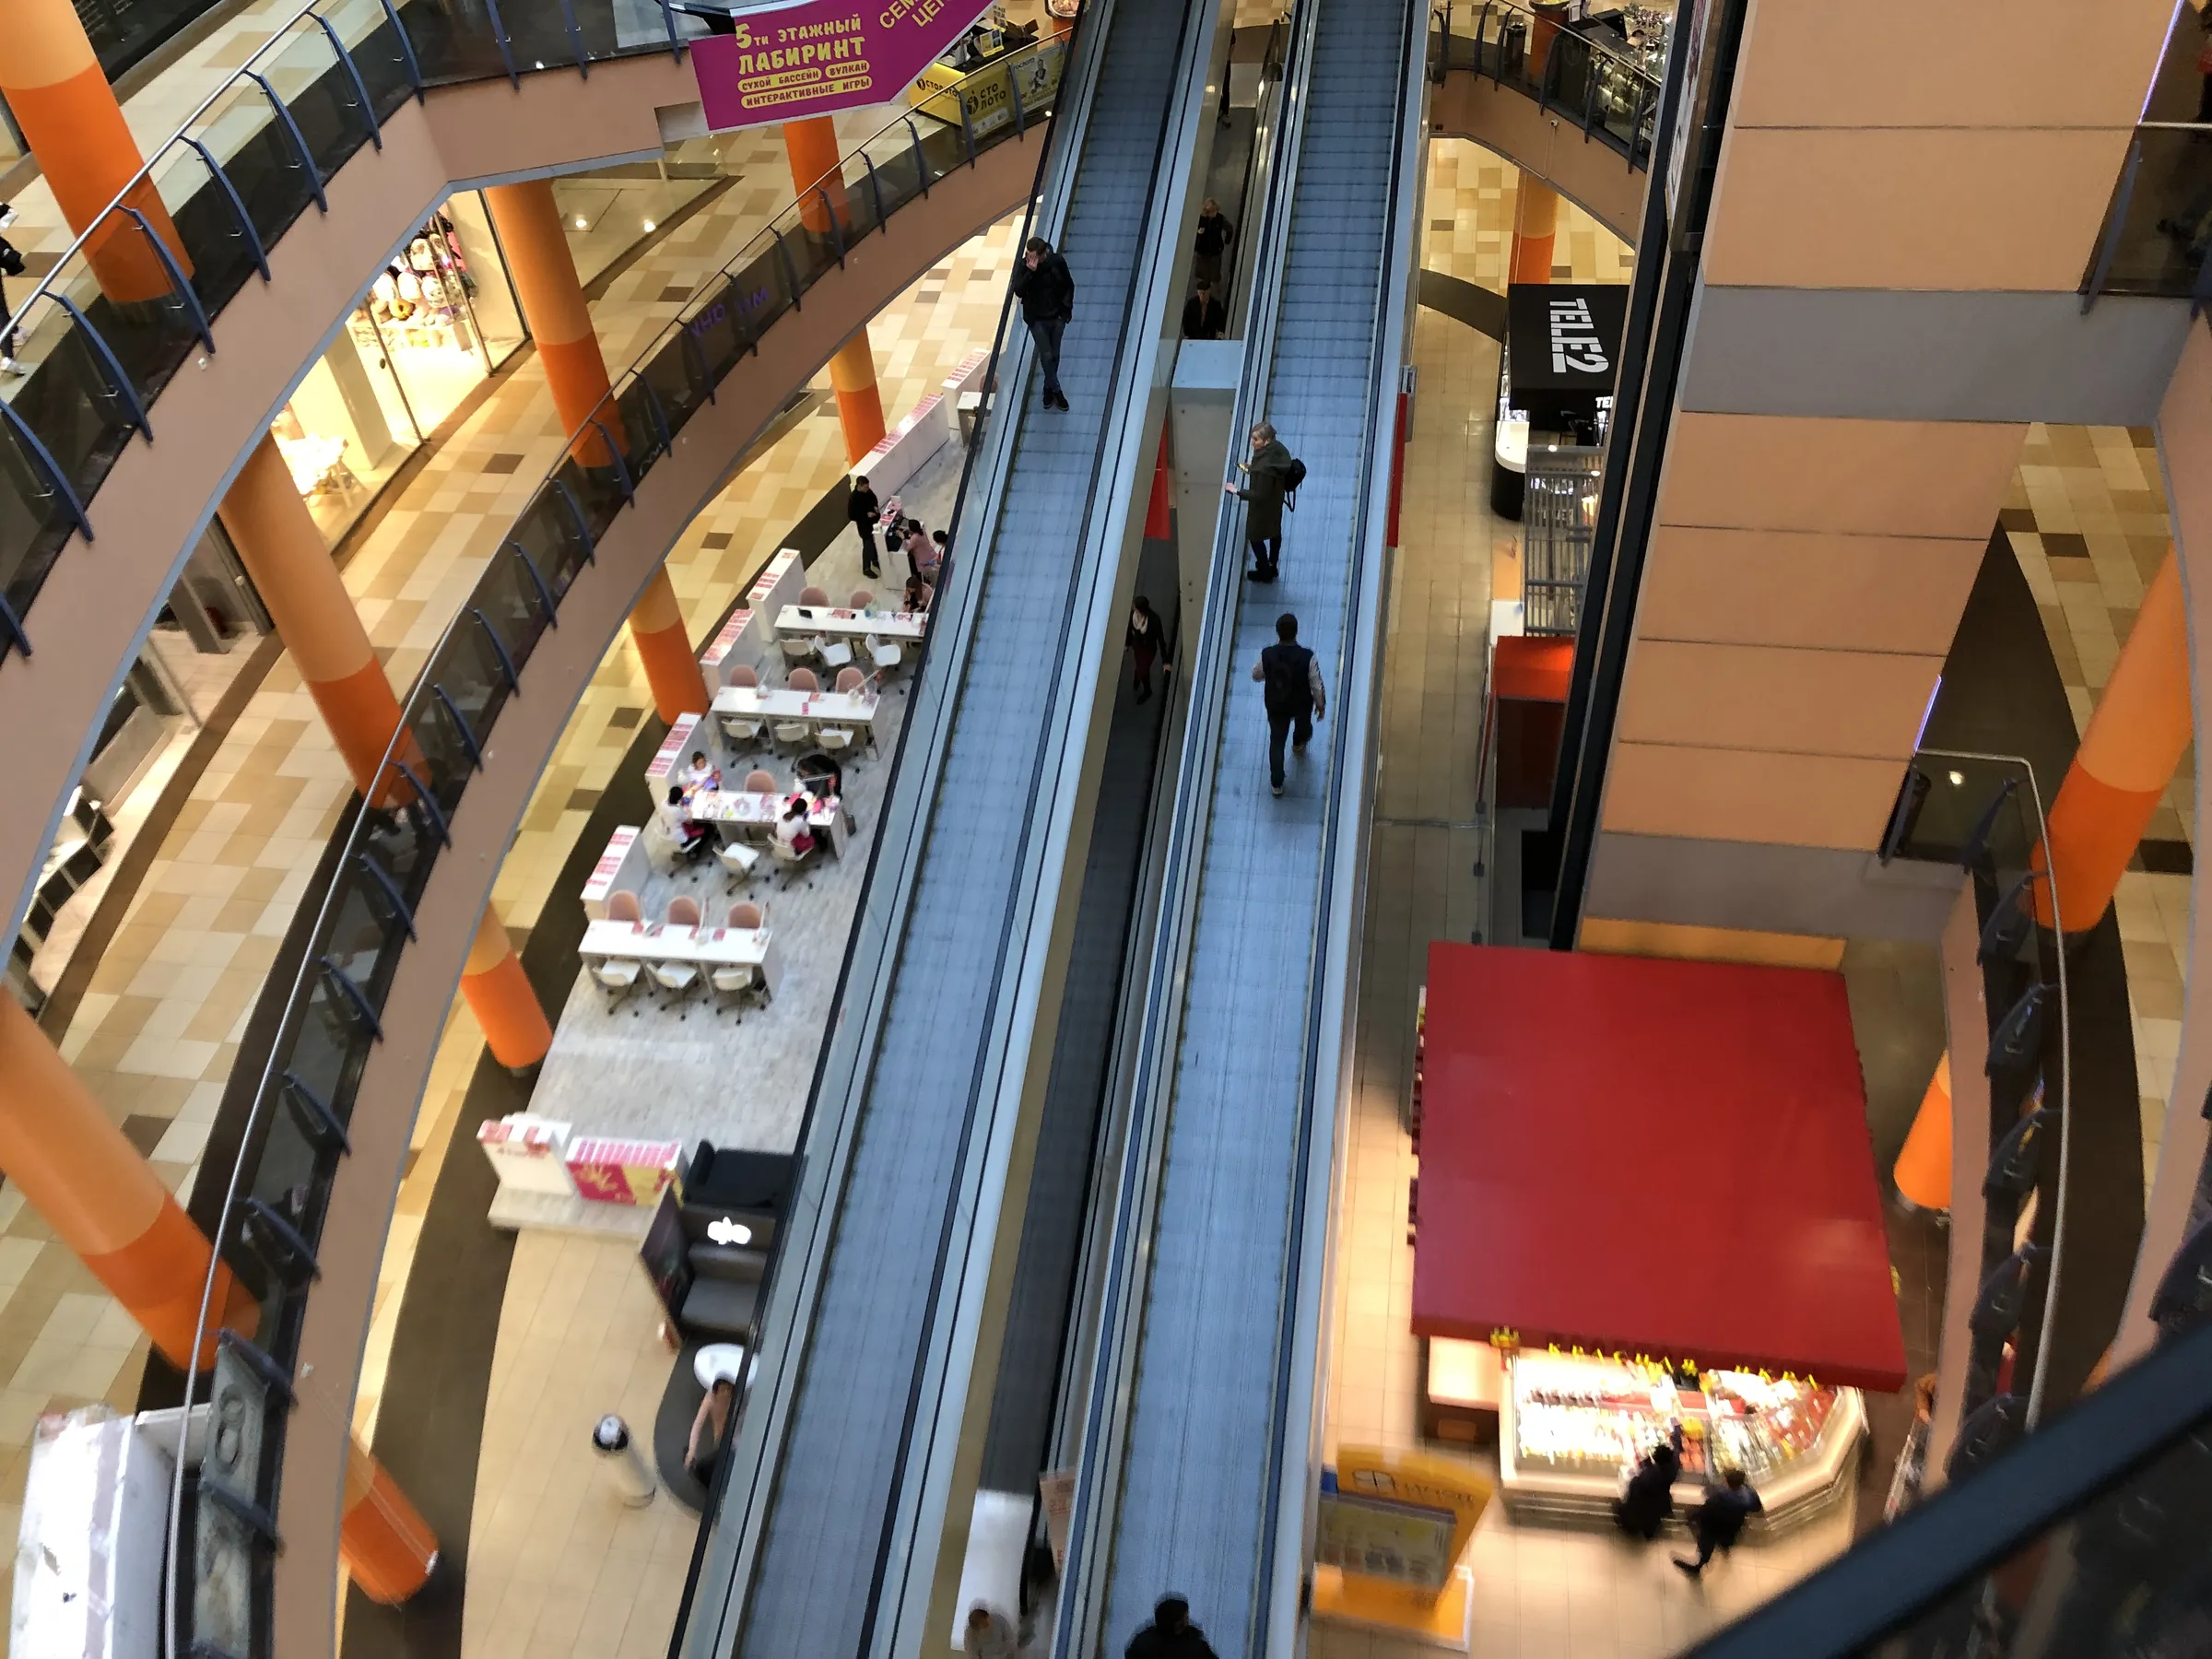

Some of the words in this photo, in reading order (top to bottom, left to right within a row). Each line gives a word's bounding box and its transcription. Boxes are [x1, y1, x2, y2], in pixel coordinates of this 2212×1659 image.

[777, 13, 862, 42] ЭТАЖНЫЙ
[738, 37, 865, 75] ЛАБИРИНТ
[742, 76, 771, 90] СУХОЙ
[779, 70, 819, 84] БАССЕЙН
[830, 63, 867, 76] ВУЛКАН
[747, 84, 834, 106] ИНТЕРАКТИВНЫЕ
[842, 78, 870, 90] ИГРЫ
[980, 83, 999, 99] СТО
[981, 90, 1006, 110] ЛОТО
[1549, 298, 1609, 373] TELE2
